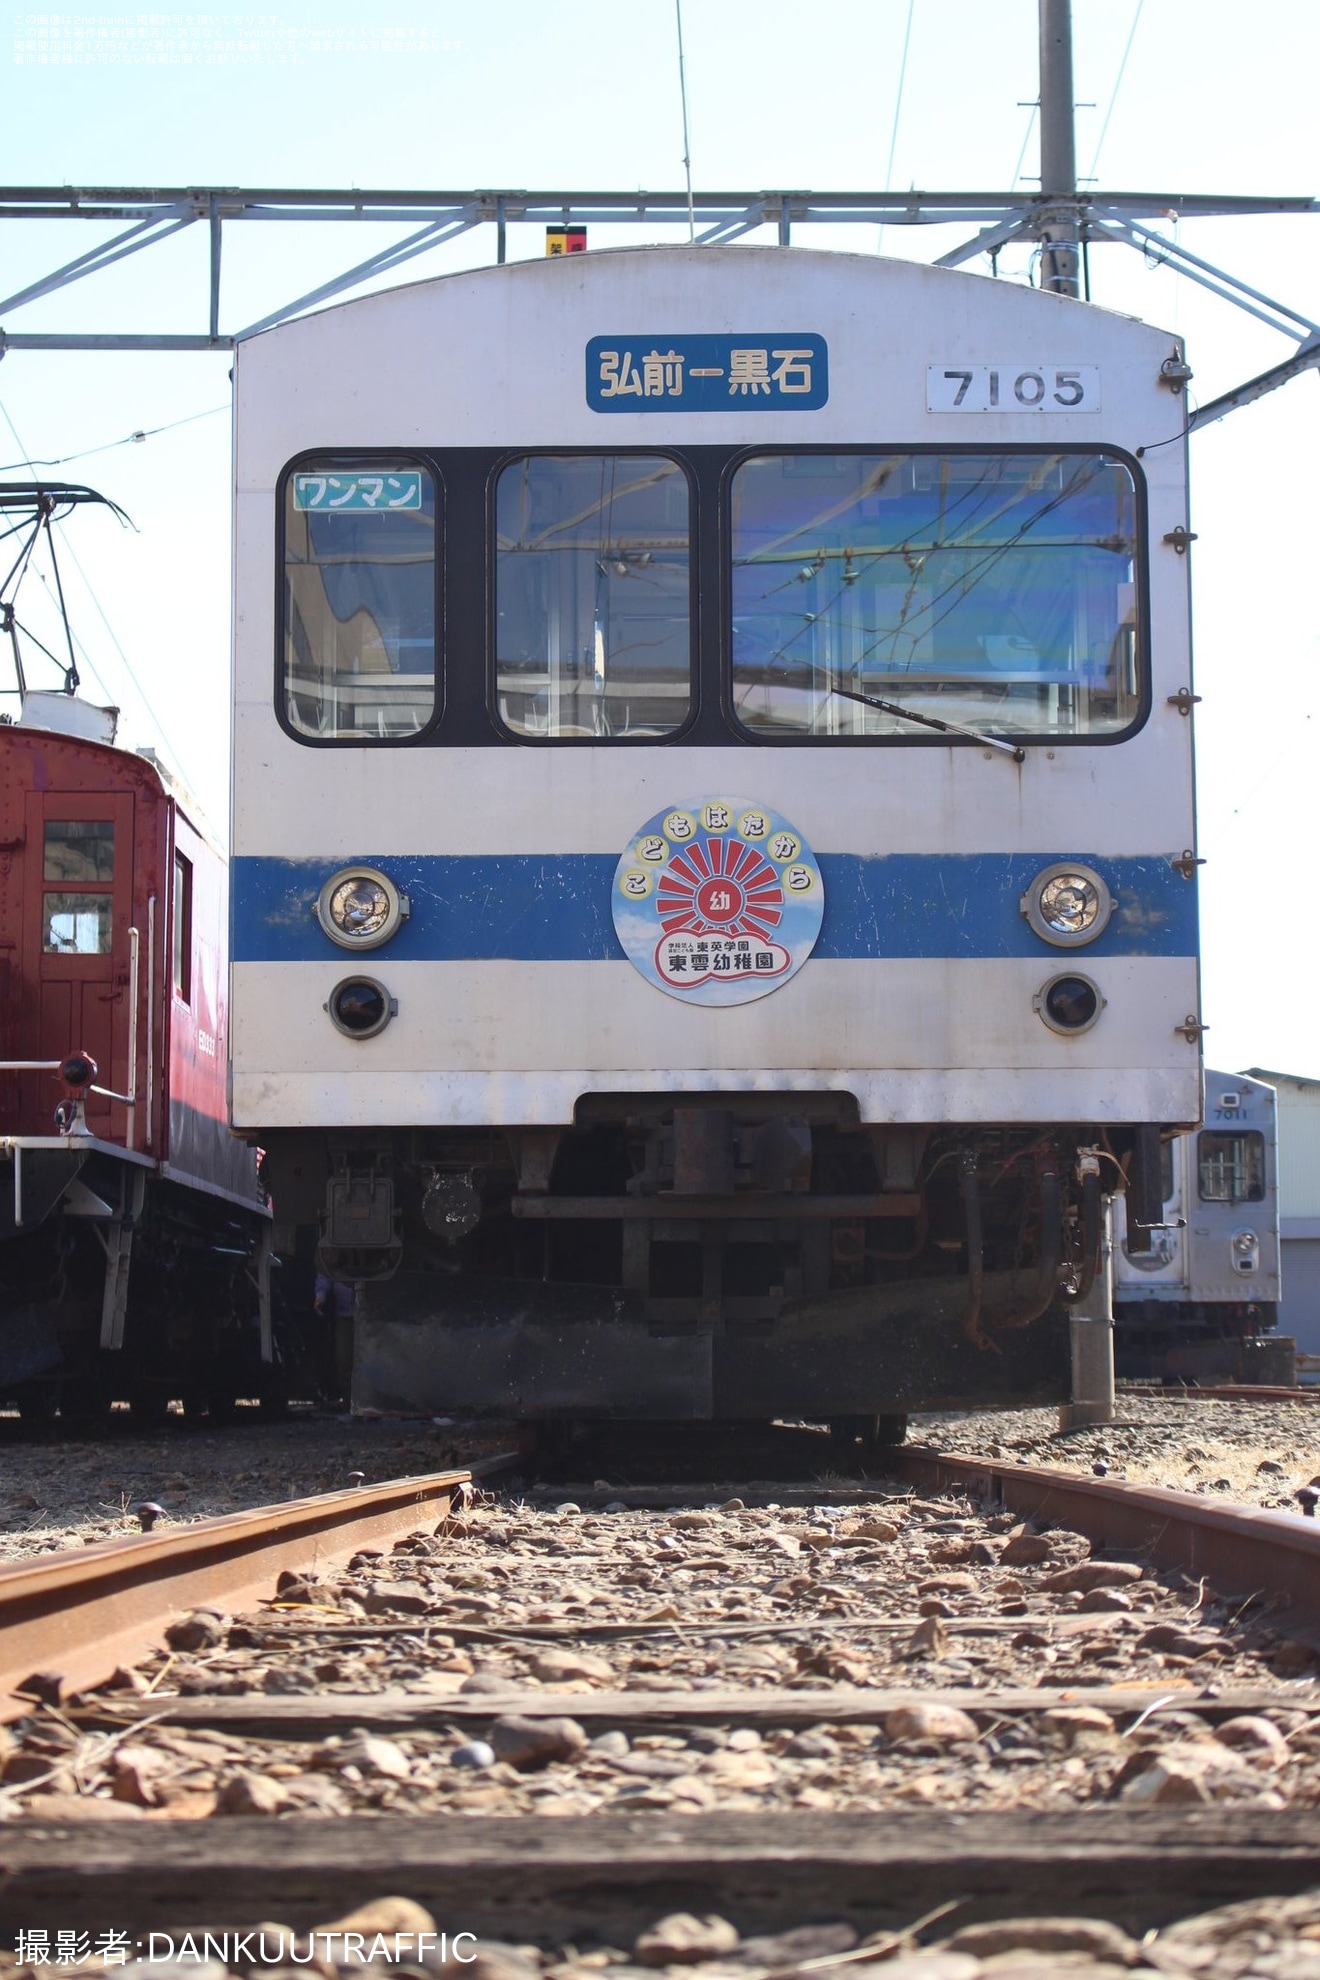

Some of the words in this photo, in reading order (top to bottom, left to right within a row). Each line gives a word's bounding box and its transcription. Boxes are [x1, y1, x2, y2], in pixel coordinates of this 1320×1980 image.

[944, 371, 1085, 406] 7105
[299, 477, 417, 506] ワンマン
[626, 806, 811, 894] こどもはたから
[709, 891, 730, 911] 幼
[697, 941, 749, 952] 東英学園
[668, 953, 774, 972] 東雲幼稚園
[1213, 1109, 1247, 1120] 7011
